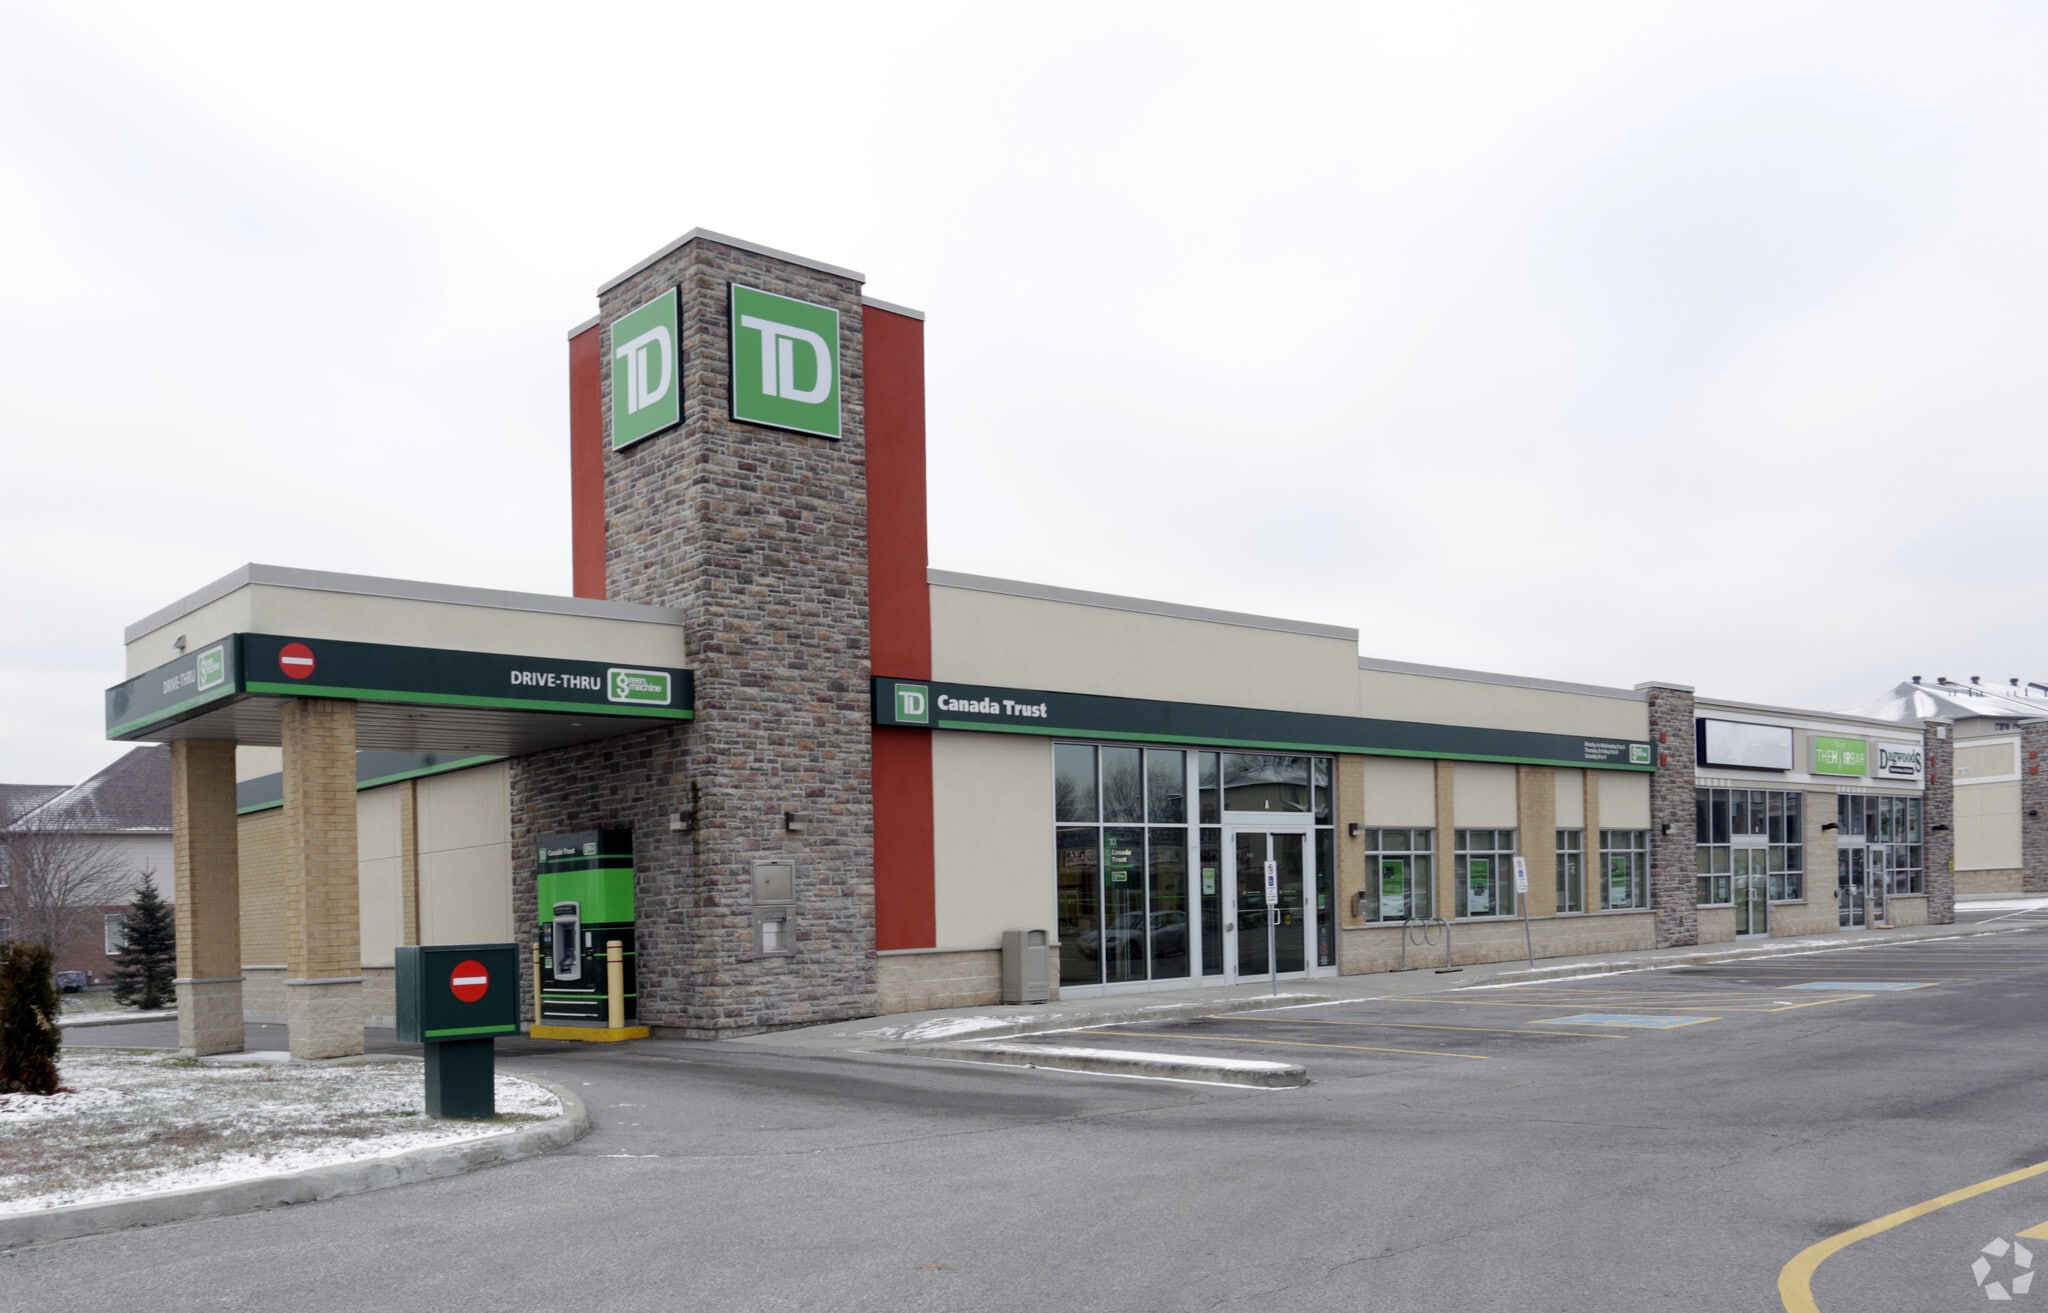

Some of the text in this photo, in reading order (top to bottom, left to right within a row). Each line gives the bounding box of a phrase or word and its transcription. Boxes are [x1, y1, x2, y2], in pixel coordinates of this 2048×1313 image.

[616, 325, 672, 415] TD
[740, 314, 832, 404] TD
[510, 670, 601, 691] DRIVE-THRU
[628, 683, 662, 693] machine
[898, 691, 1048, 718] TD Canada Trust
